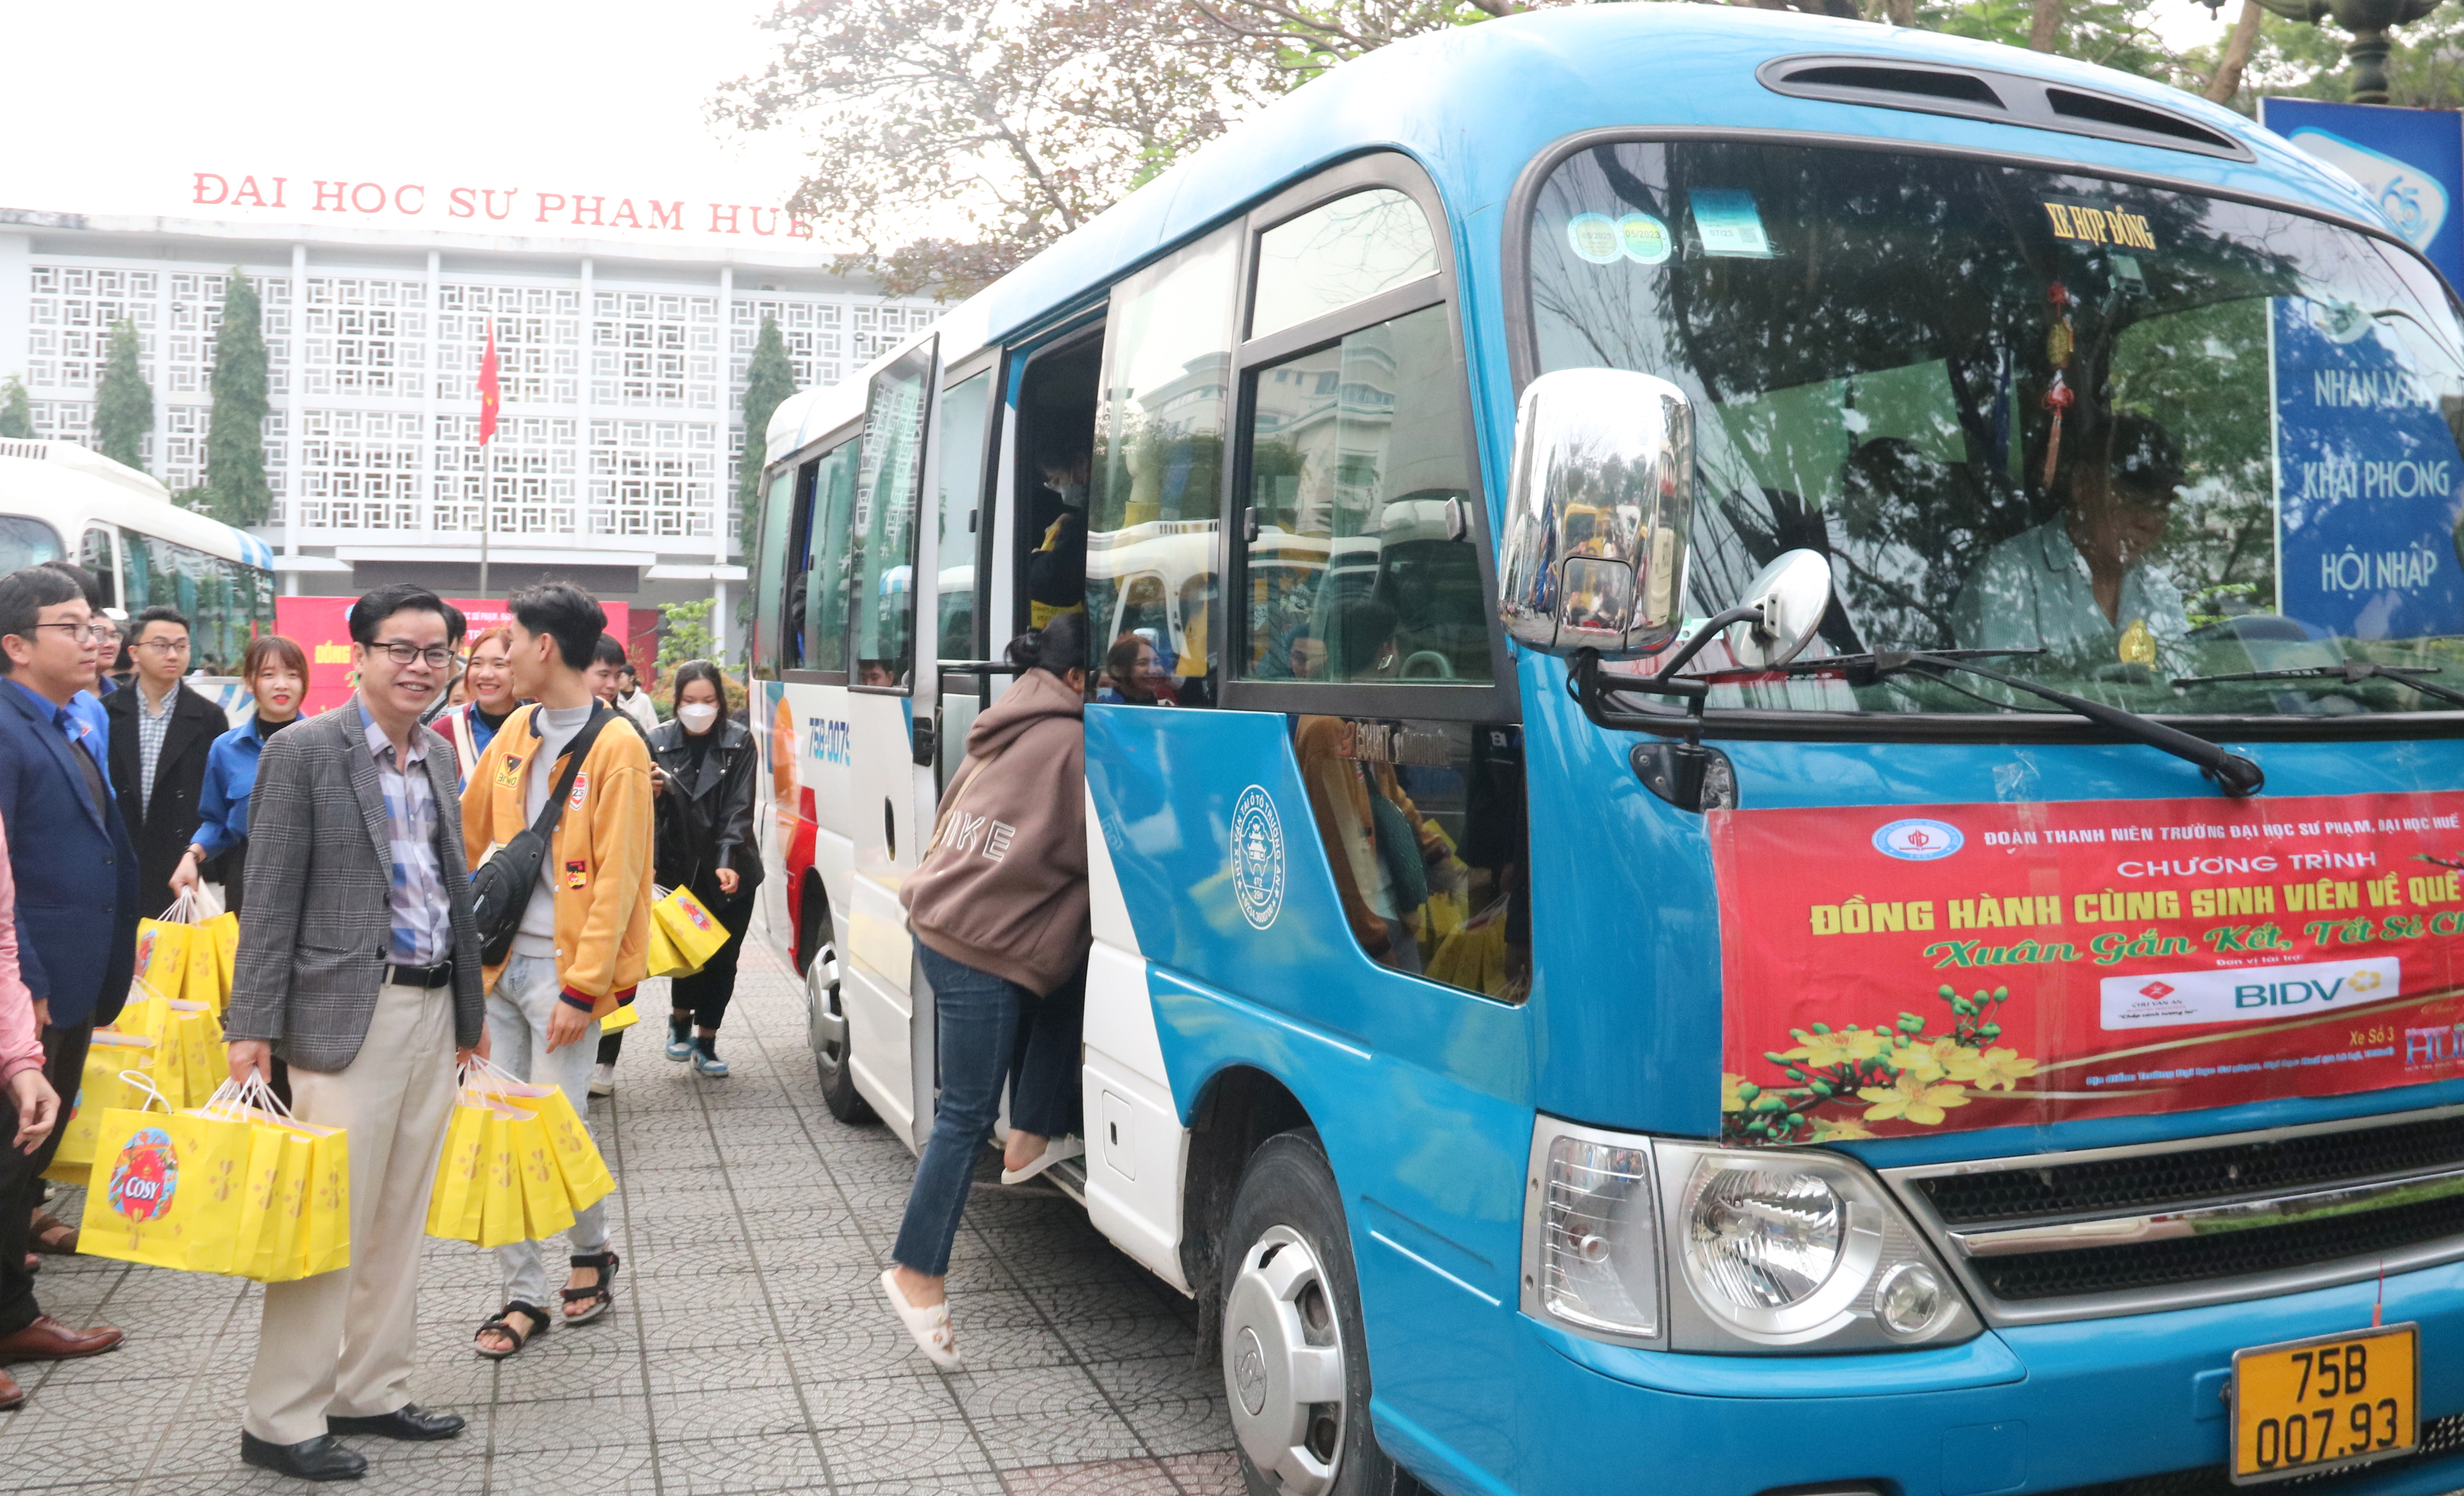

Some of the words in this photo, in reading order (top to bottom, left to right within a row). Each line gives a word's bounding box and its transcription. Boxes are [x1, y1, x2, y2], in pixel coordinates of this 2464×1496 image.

[448, 187, 519, 220] SƯ
[2044, 202, 2075, 239] XE
[1625, 229, 1661, 239] 05/2023
[2314, 360, 2378, 407] NHÂN
[2303, 459, 2358, 500] KHAI
[2321, 543, 2370, 600] HỘI
[2376, 540, 2438, 596] NHẬP
[939, 809, 1017, 863] IKE
[1984, 829, 2037, 846] ĐOÀN
[2043, 828, 2105, 844] THANH
[2111, 826, 2154, 841] NIÊN
[2159, 823, 2226, 841] TRƯỜNG
[2229, 824, 2259, 841] ĐẠI
[2263, 822, 2293, 840] HỌC
[2298, 820, 2320, 836] SƯ
[2378, 817, 2401, 835] ĐẠI
[2403, 816, 2431, 833] HỌC
[2117, 855, 2279, 878] CHƯƠNG
[2288, 850, 2377, 870] TRÌNH
[1809, 894, 1935, 936] ĐỒNG
[1947, 892, 2062, 930] HÀNH
[2074, 887, 2181, 923] CÙNG
[2190, 885, 2275, 918] SINH
[2282, 877, 2358, 912] VIÊN
[2365, 871, 2401, 907] VỀ
[2407, 869, 2461, 907] QUÊ
[1922, 938, 2083, 970] Xuân
[2089, 928, 2197, 966] Gắn
[2203, 921, 2292, 953] Kết,
[2303, 913, 2376, 947] Tết
[2234, 976, 2346, 1009] BIDV
[2349, 1030, 2365, 1046] Xe
[2368, 1024, 2385, 1043] Số
[2387, 1026, 2395, 1041] 3
[2405, 1031, 2464, 1064] HU
[2291, 1343, 2367, 1403] 75B
[2256, 1397, 2397, 1469] 007.93
